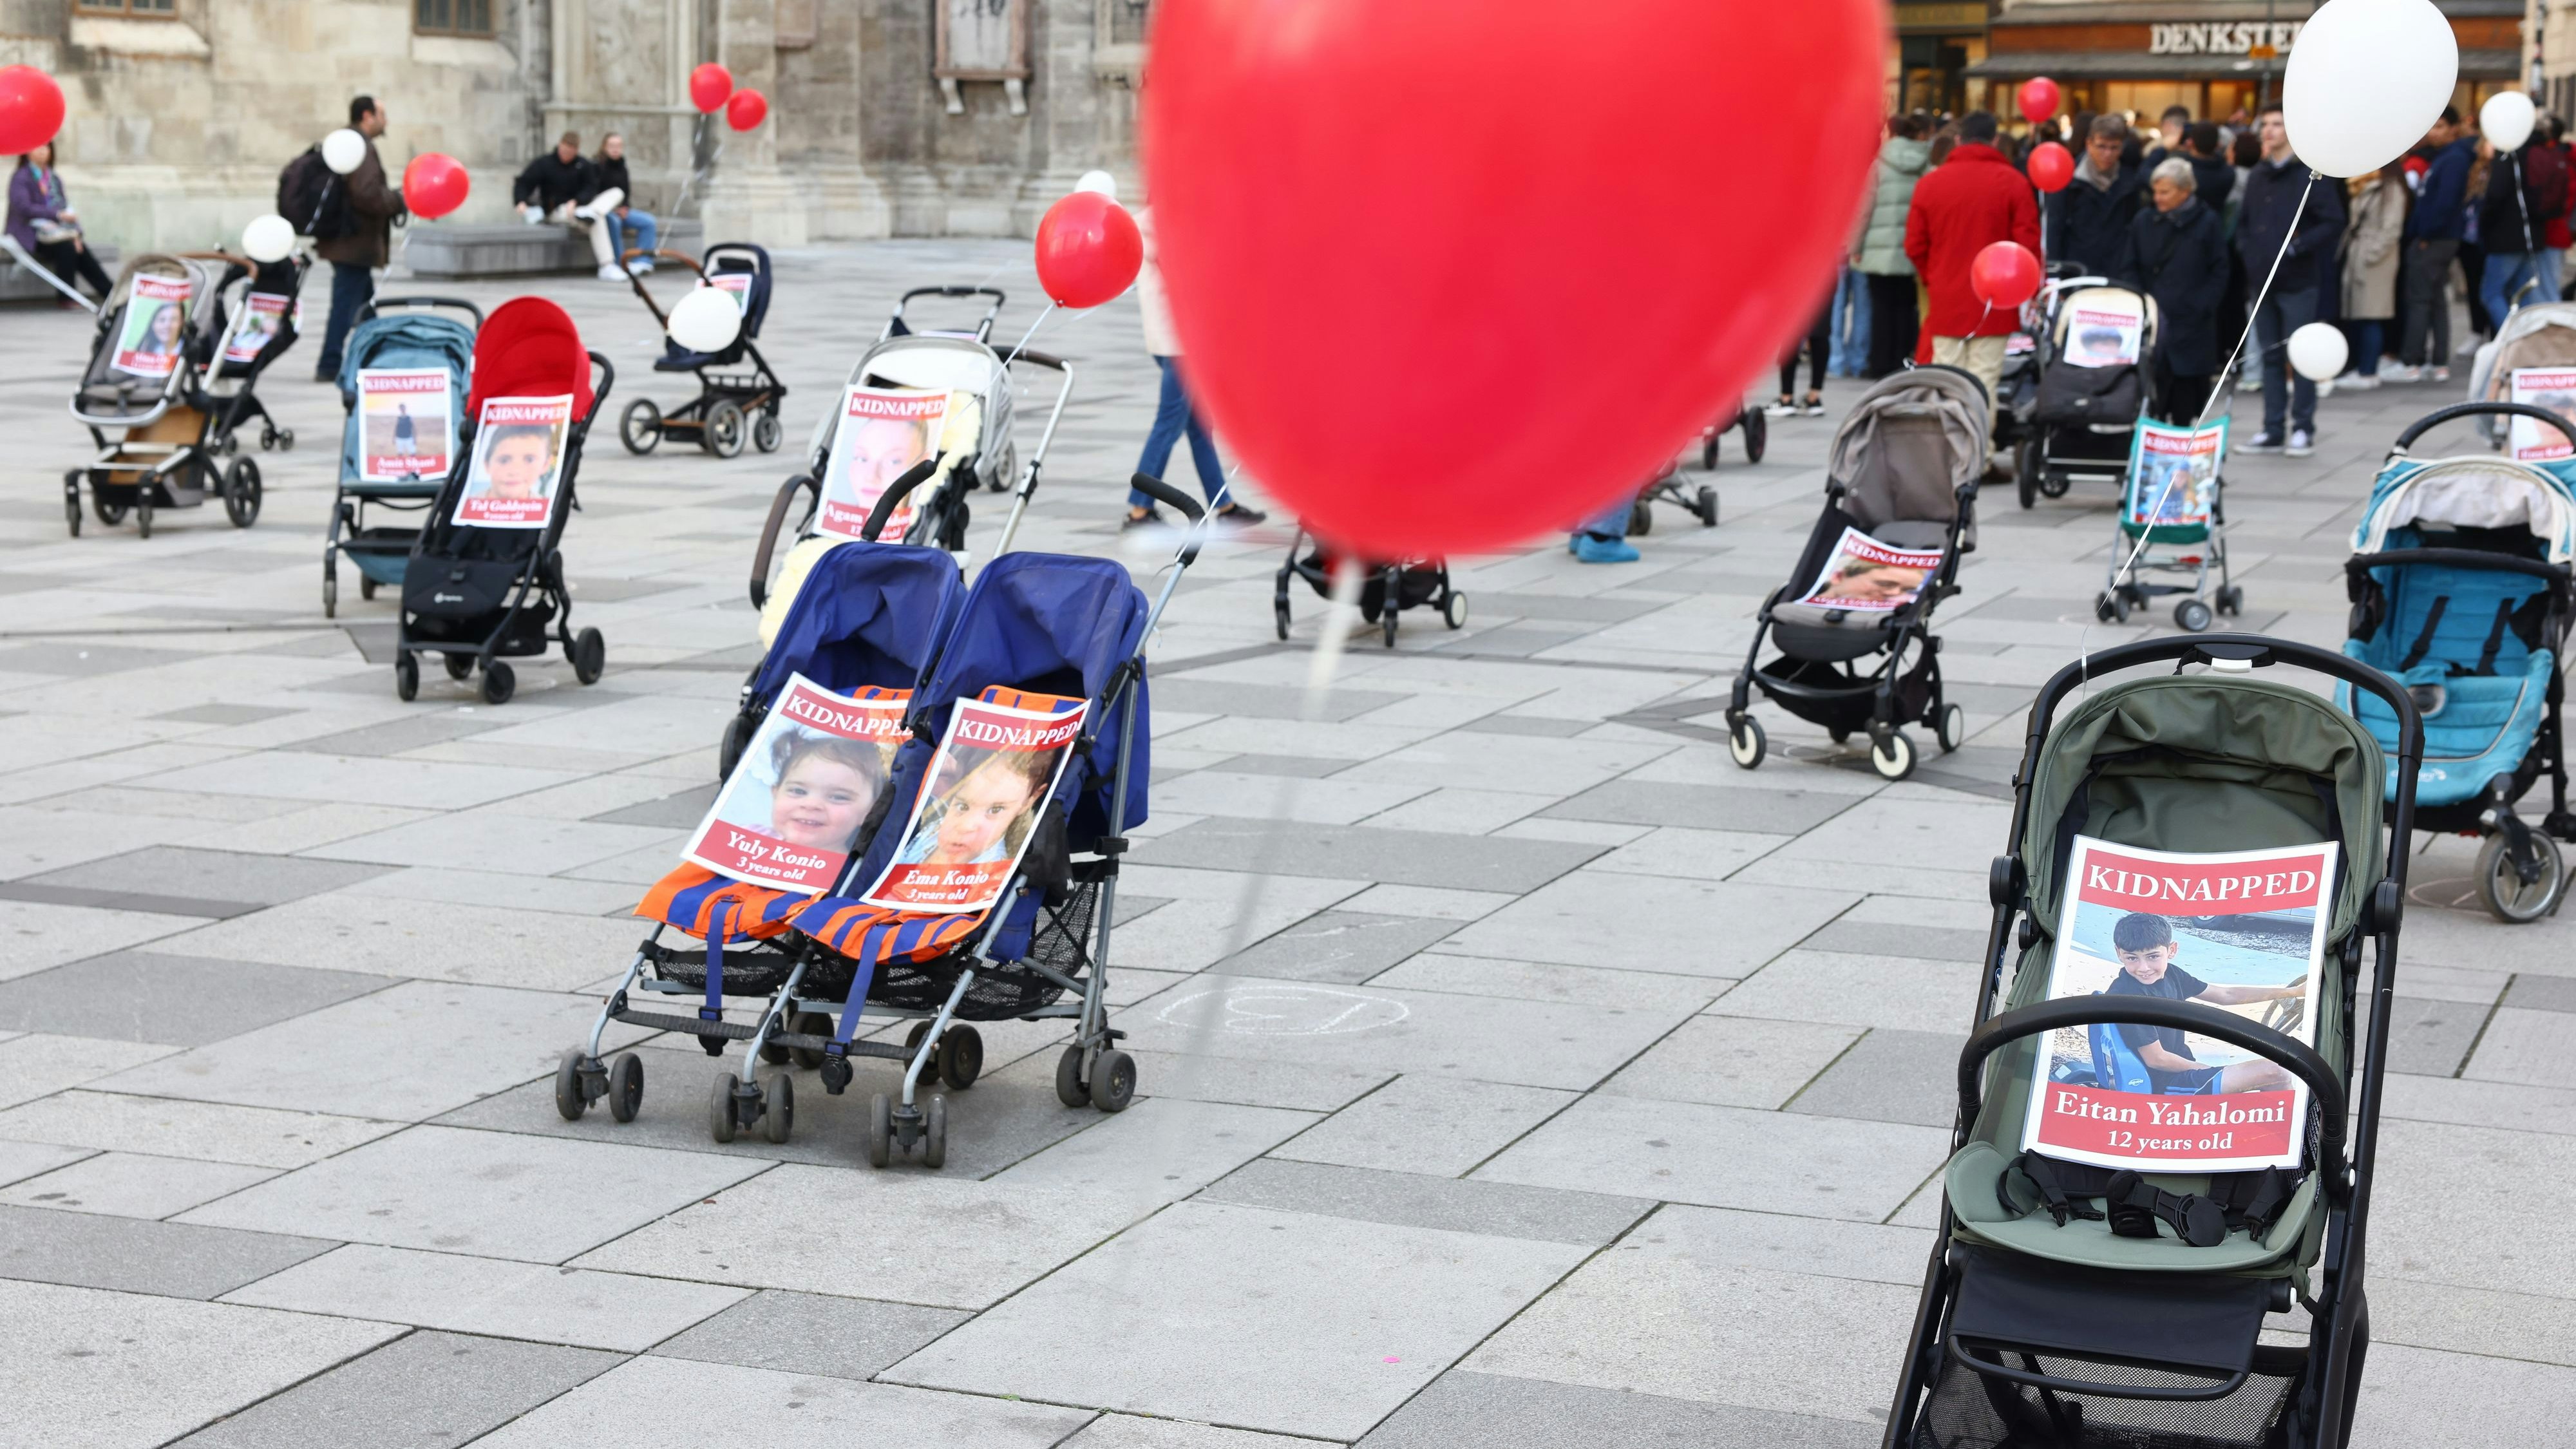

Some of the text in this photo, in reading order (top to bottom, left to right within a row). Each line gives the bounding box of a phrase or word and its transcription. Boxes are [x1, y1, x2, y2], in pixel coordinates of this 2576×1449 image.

[486, 405, 567, 421] KIDNAPPED
[851, 397, 945, 416] KIDNAPPED
[825, 504, 863, 524] Agam
[1844, 539, 1941, 567] KIDNAPPED
[956, 719, 1078, 746] KIDNAPPED
[726, 830, 826, 869] Yuly Konio
[736, 856, 807, 880] 3 years old
[903, 871, 989, 886] Ema Konio
[2087, 864, 2316, 901] KIDNAPPED
[906, 889, 968, 902] 3 years old
[2054, 1090, 2286, 1127] Eitan Yahalomi
[2107, 1130, 2233, 1154] 12 years old
